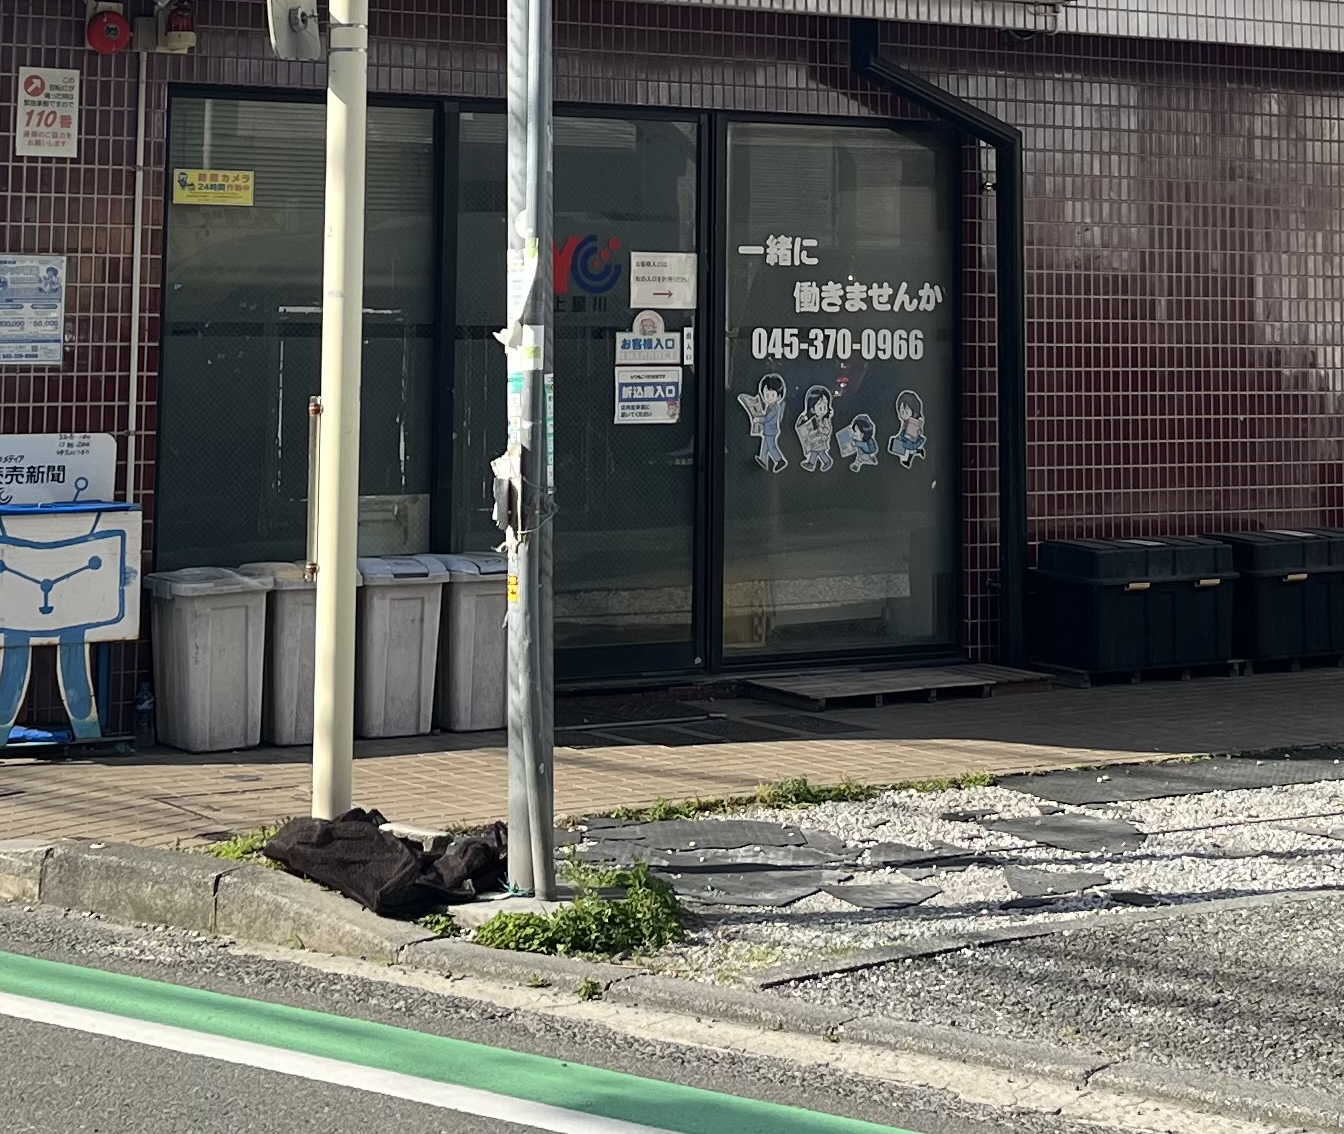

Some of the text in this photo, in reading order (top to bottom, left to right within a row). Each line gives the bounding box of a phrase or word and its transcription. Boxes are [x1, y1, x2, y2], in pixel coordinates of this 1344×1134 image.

[738, 234, 819, 266] 一緒に
[793, 281, 943, 313] 働きませんか
[620, 338, 675, 350] お客様入口
[751, 327, 924, 360] 045-370-0966
